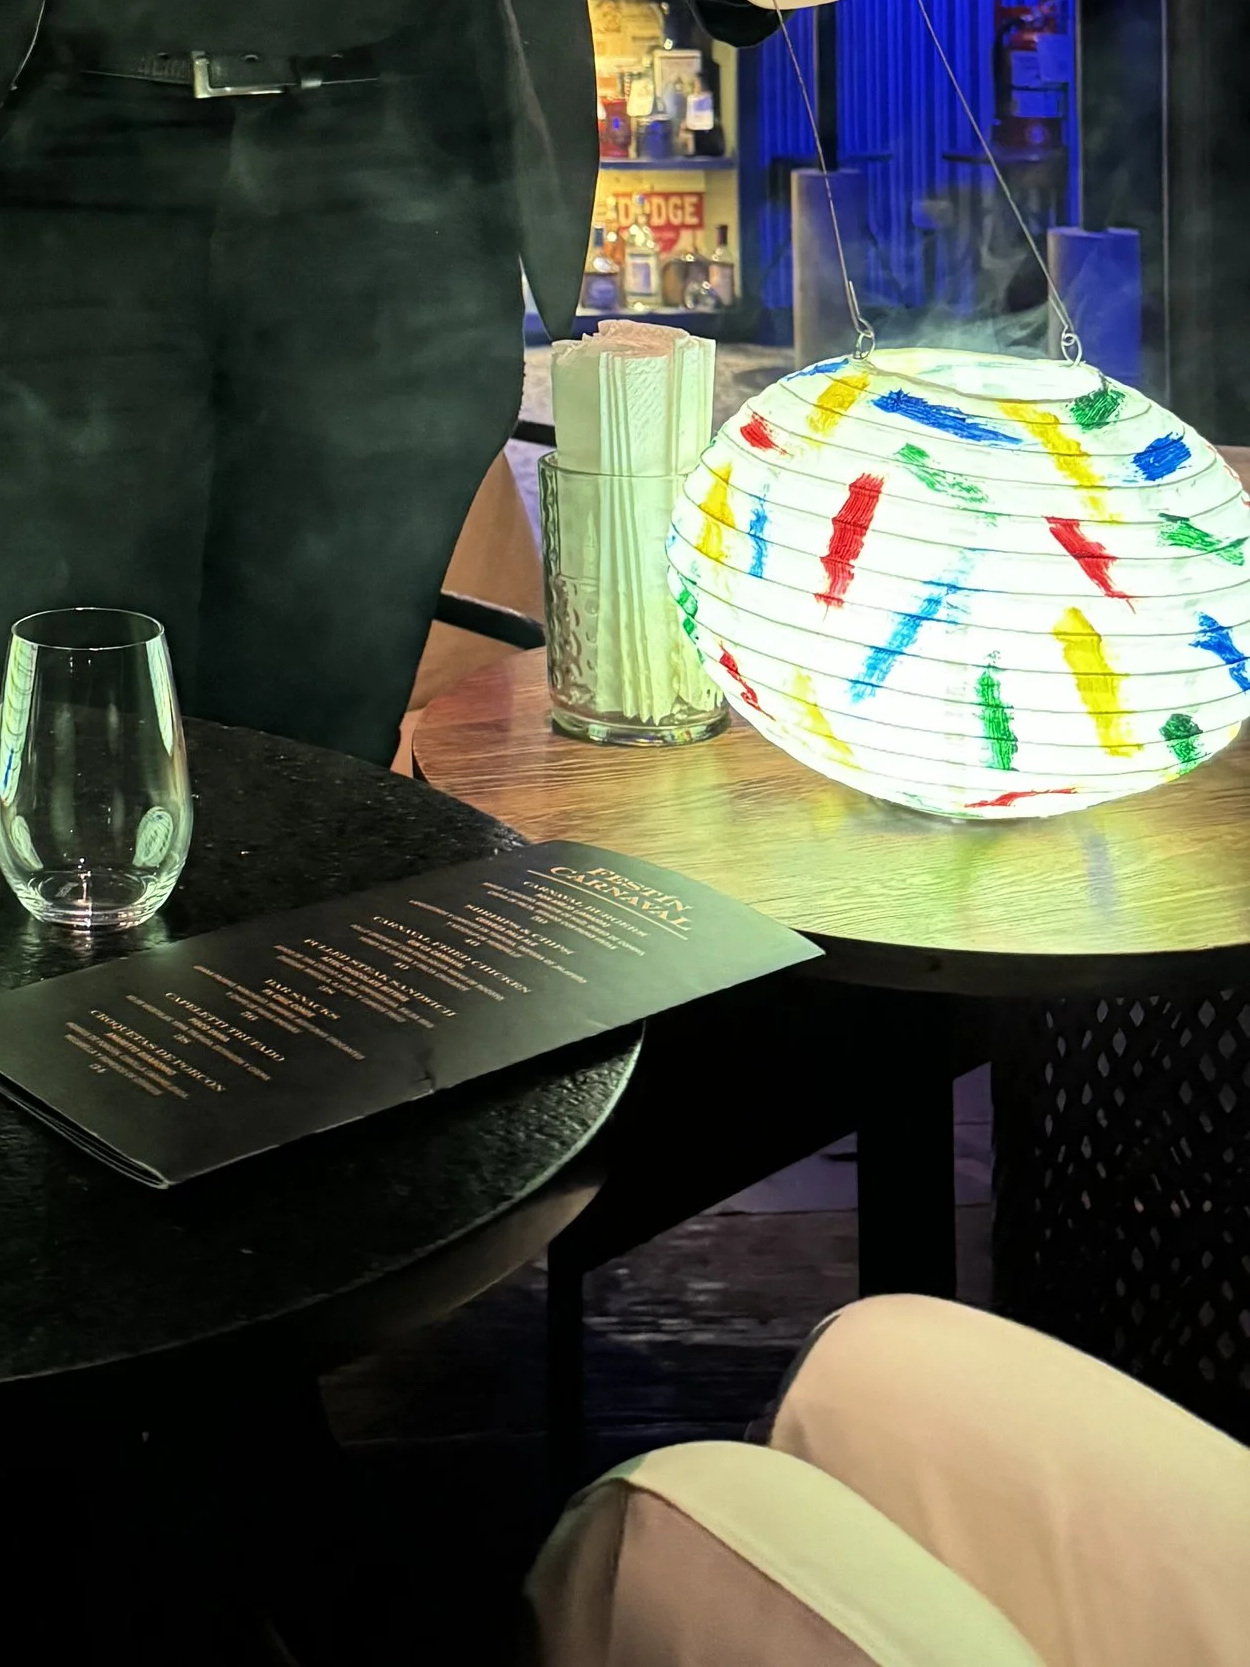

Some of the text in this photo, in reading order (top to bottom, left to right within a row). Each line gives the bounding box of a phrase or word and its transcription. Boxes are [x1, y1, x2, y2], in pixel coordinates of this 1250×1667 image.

[617, 195, 700, 228] DDGE
[549, 865, 693, 932] CARNAVAL
[587, 866, 695, 912] FESTÍN
[304, 938, 350, 961] PULLED
[350, 959, 388, 981] STEAK
[390, 980, 456, 1017] SANDWICH
[373, 916, 430, 943] CARNAVAL
[432, 941, 471, 961] FRIED
[471, 960, 531, 993] CHICKEN
[264, 978, 292, 993] BAR
[292, 992, 340, 1020] SNACKS
[90, 1010, 157, 1049] CROQUETAS
[155, 1048, 176, 1061] DE
[228, 1027, 285, 1062] TRUFADO
